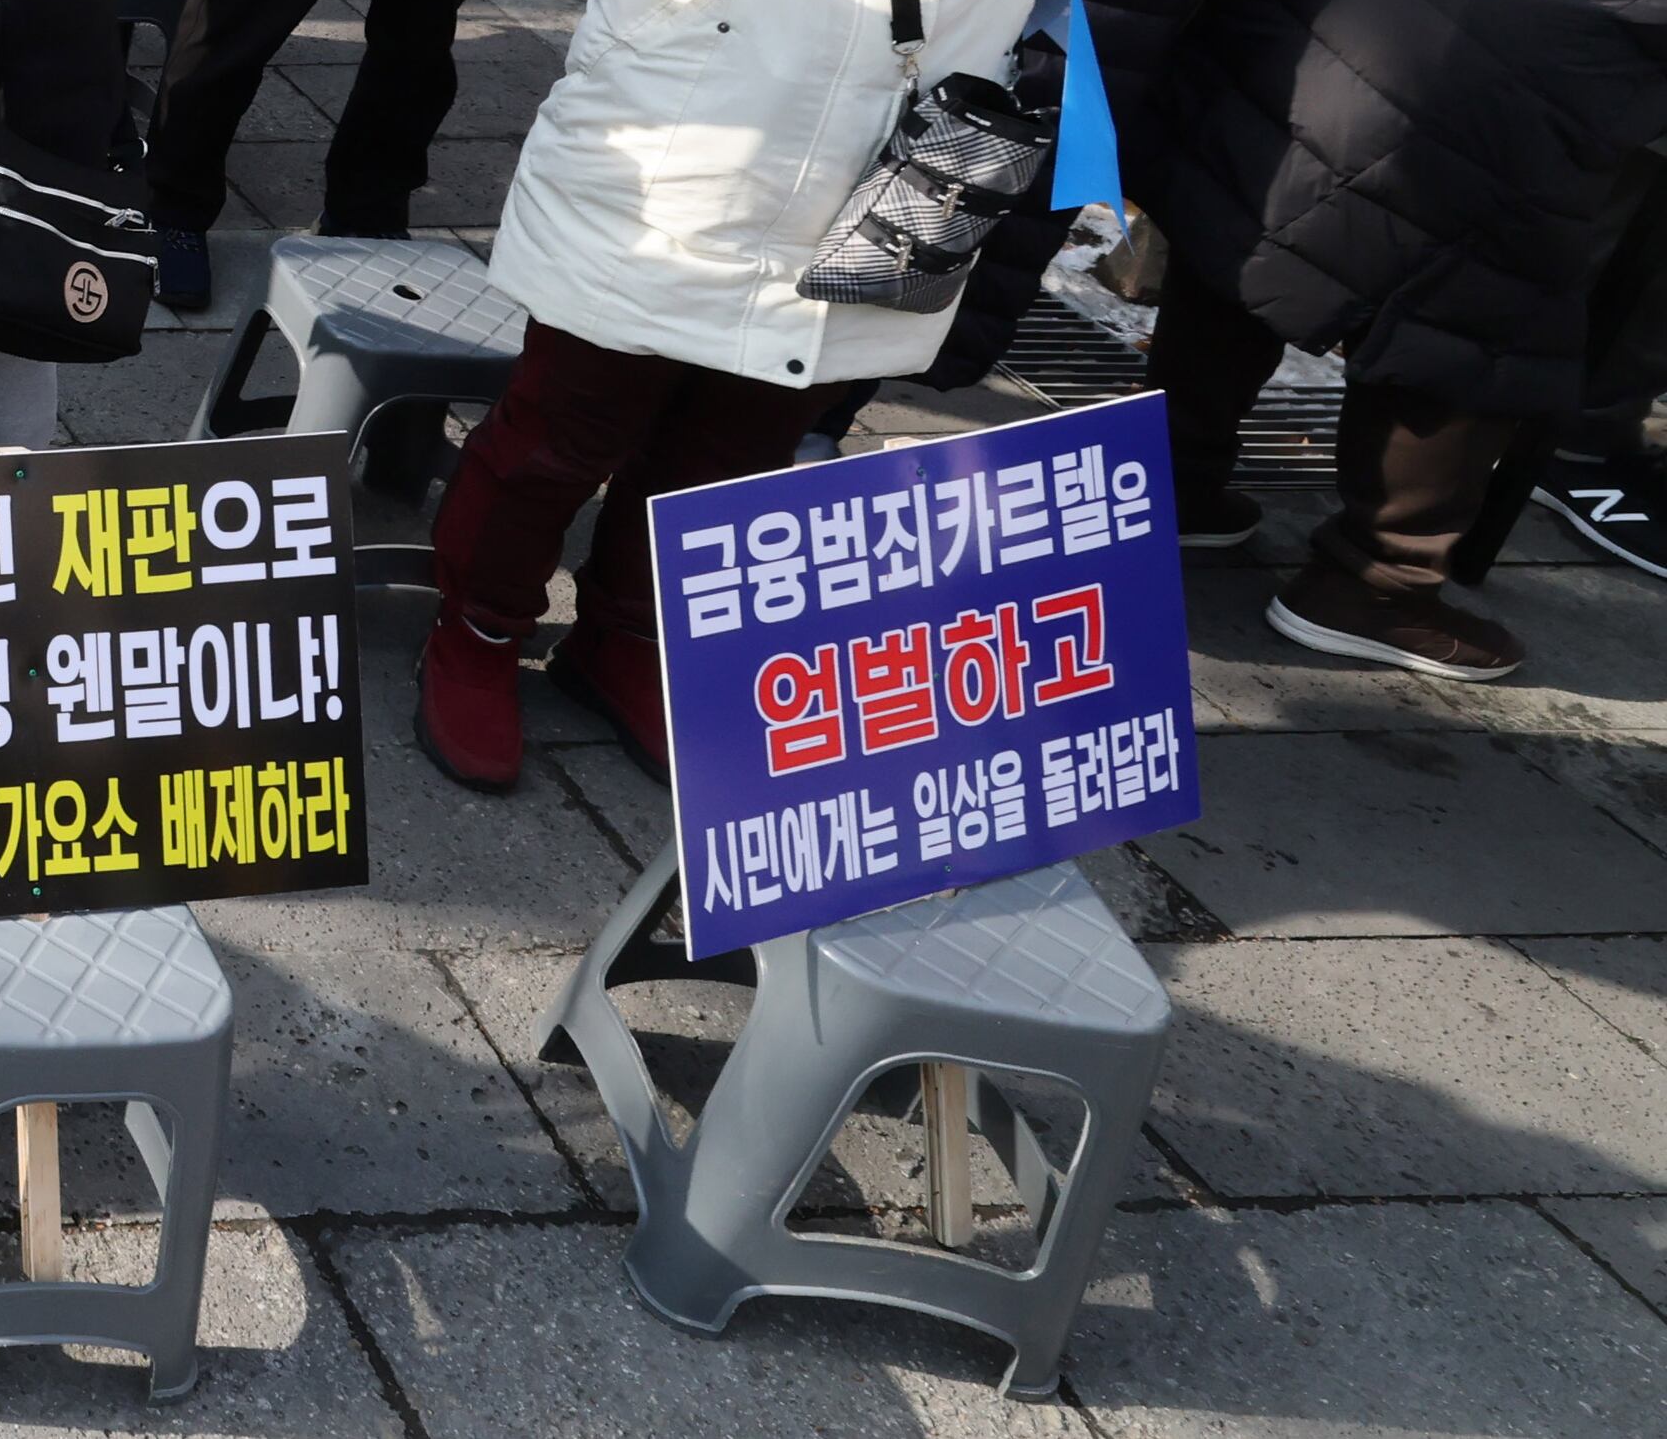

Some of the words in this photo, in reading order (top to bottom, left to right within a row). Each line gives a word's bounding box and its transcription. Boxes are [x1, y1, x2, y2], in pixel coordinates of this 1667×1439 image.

[51, 474, 337, 598] 재판으로
[680, 443, 1152, 640] 금융범죄카르텔은
[45, 613, 344, 745] 웬말이냐!
[753, 583, 1115, 779] 엄벌하고
[158, 756, 350, 870] 배제하라
[703, 788, 900, 914] 시민에게는
[913, 749, 1027, 863] 일상을
[1041, 707, 1180, 830] 돌려달라
